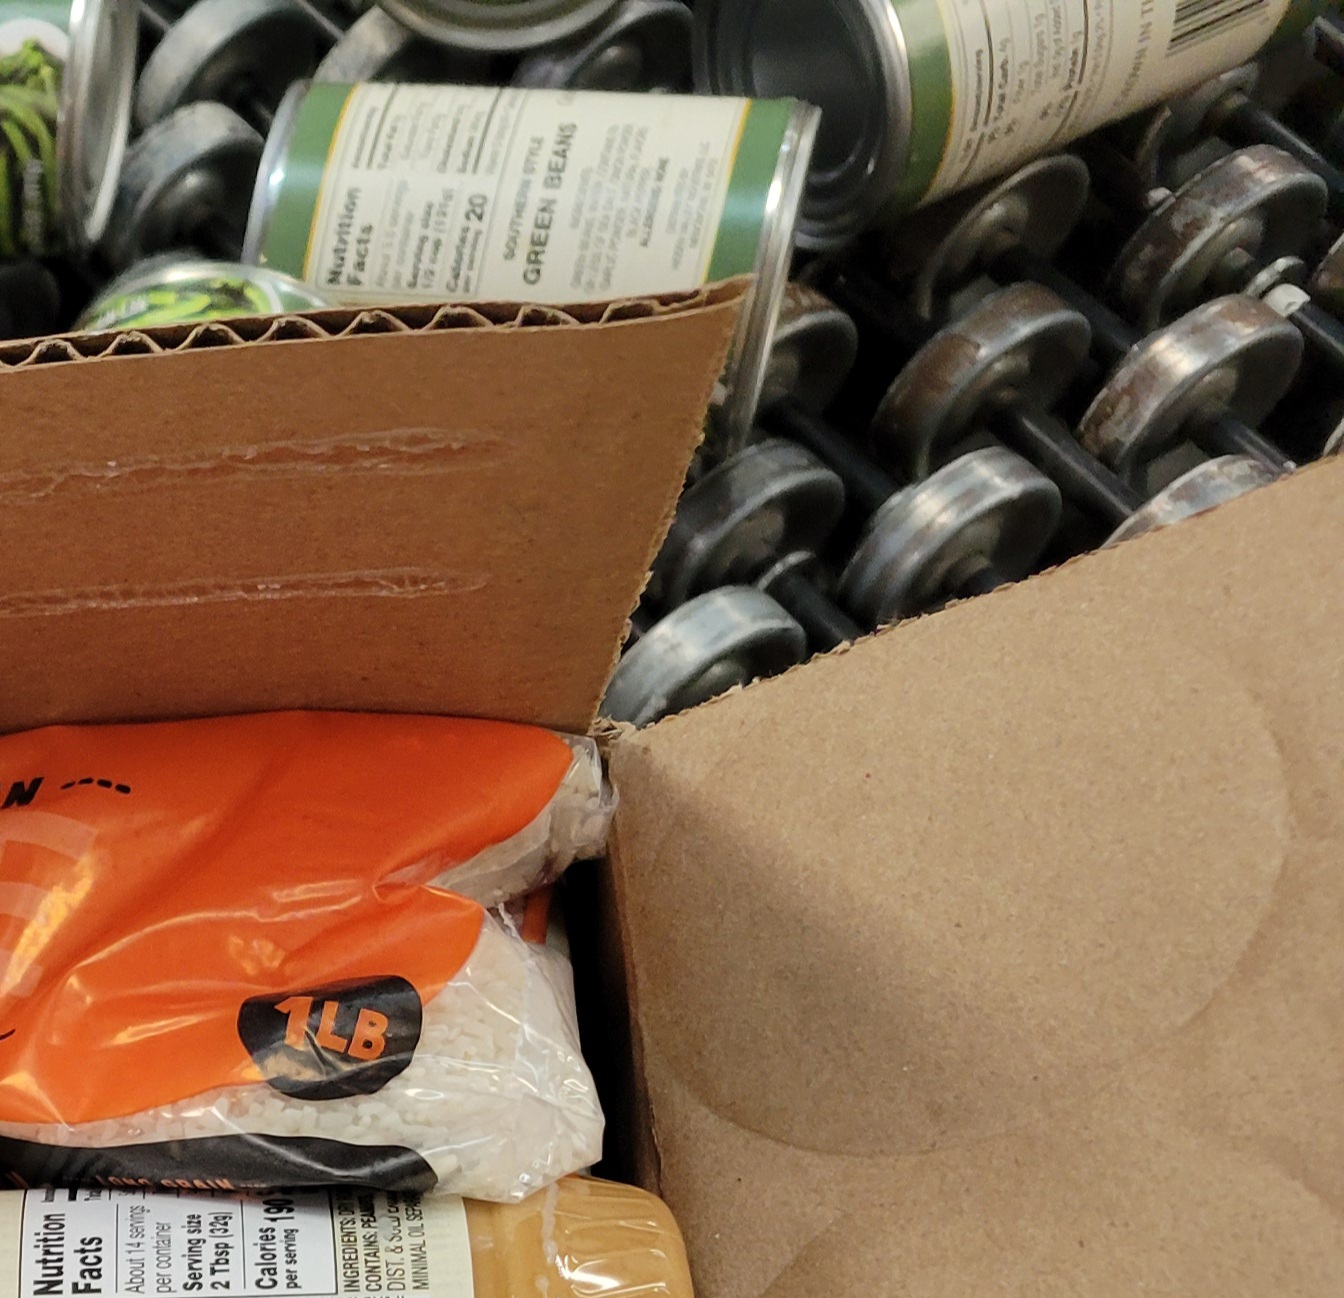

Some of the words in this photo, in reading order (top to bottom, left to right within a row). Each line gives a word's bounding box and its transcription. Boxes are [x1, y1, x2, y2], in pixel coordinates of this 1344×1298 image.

[464, 193, 488, 223] 20
[522, 198, 557, 285] GREEN
[542, 122, 577, 190] BEANS
[347, 224, 374, 286] Facts
[127, 1205, 150, 1238] servings
[184, 1214, 202, 1234] size
[208, 1211, 233, 1238] (32g)
[263, 1199, 295, 1222] 190
[153, 1222, 172, 1269] container
[411, 1223, 426, 1237] OIL
[33, 1212, 65, 1296] Nutrition
[125, 1242, 144, 1254] 14
[210, 1242, 234, 1275] Tbsp
[253, 1227, 278, 1289] Calories
[281, 1229, 299, 1265] serving
[338, 1217, 360, 1293] INGREDIENTS:
[362, 1232, 382, 1292] CONTAINS:
[384, 1246, 403, 1254] &
[72, 1237, 102, 1294] Facts
[125, 1257, 145, 1294] About
[182, 1239, 206, 1291] Serving
[285, 1269, 301, 1289] per
[386, 1258, 405, 1291] DIST.
[408, 1239, 429, 1290] MINIMAL
[157, 1273, 177, 1293] per
[211, 1281, 230, 1289] 2
